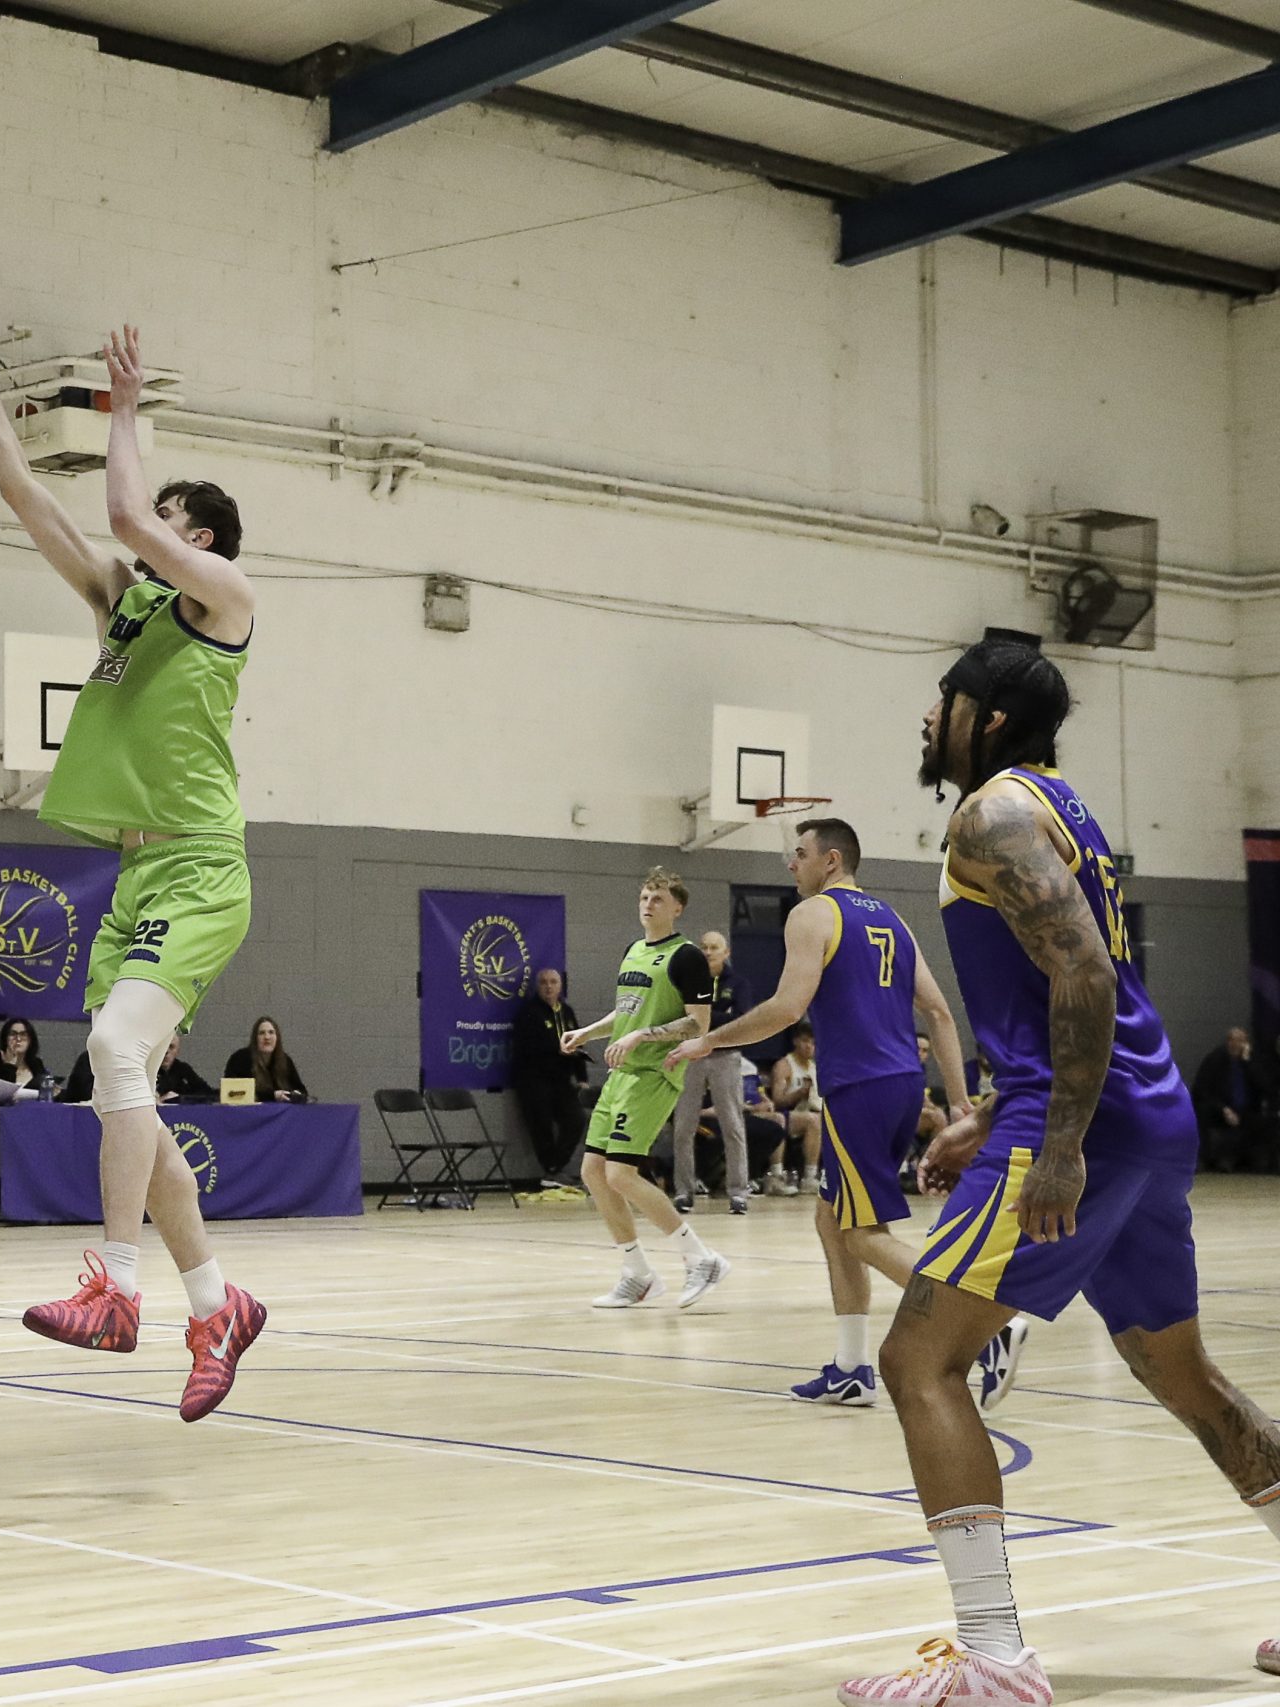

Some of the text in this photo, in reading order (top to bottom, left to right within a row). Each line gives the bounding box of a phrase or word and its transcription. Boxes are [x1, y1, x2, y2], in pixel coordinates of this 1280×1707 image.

[0, 868, 78, 937] BASKETBALL
[56, 943, 78, 989] CLUB
[130, 919, 170, 947] 22
[486, 915, 530, 963] BASKETBALL
[652, 954, 665, 966] 2
[864, 925, 895, 987] 7
[614, 1112, 627, 1131] 2
[205, 1166, 218, 1193] CLUB
